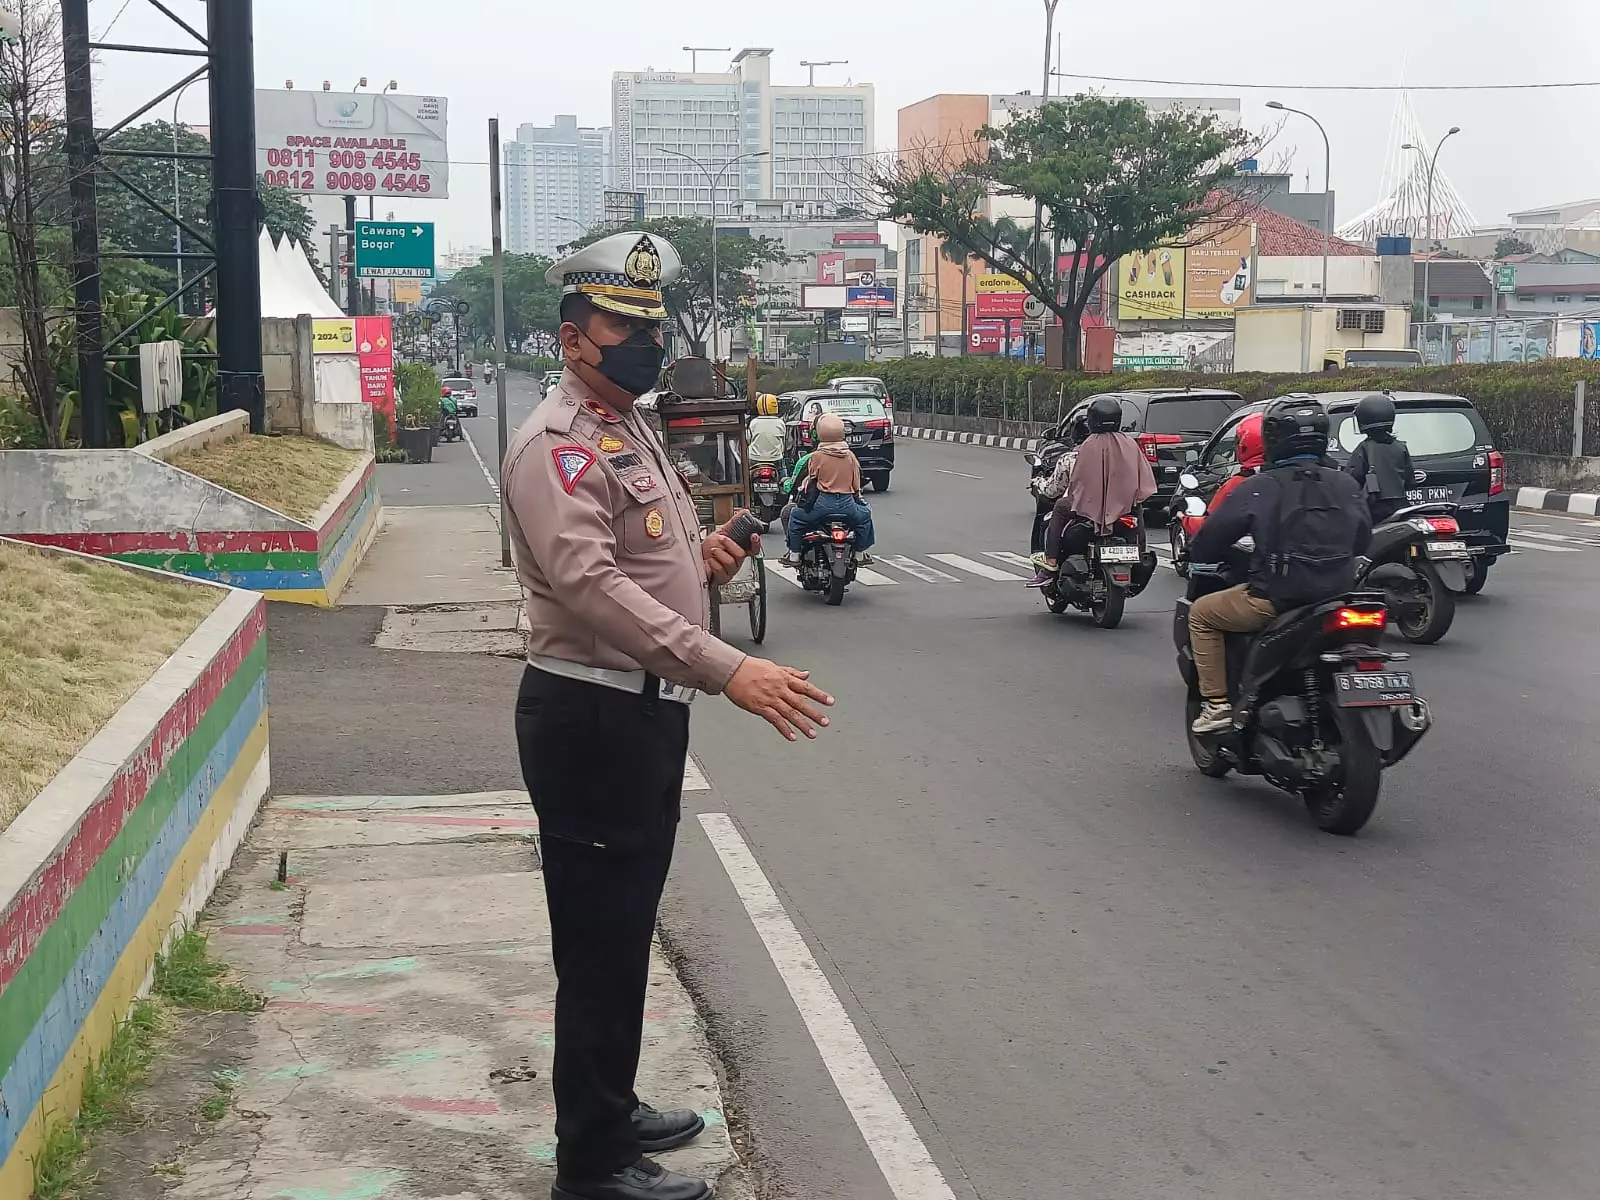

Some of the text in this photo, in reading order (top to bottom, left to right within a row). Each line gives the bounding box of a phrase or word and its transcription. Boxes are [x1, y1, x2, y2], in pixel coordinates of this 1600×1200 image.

[286, 136, 407, 151] SPACE AVAILABLE
[267, 148, 421, 171] 0811 908 4545
[264, 170, 431, 193] 0812 9089 4545
[361, 225, 406, 238] Cawang
[361, 240, 395, 251] Bogor
[362, 267, 430, 277] LEWAT JALAN TOL
[979, 279, 1011, 287] erafone
[1125, 290, 1176, 299] CASHBACK
[1024, 301, 1035, 310] 40
[317, 333, 339, 341] 2024
[971, 333, 980, 347] 9
[1428, 488, 1447, 500] PKN
